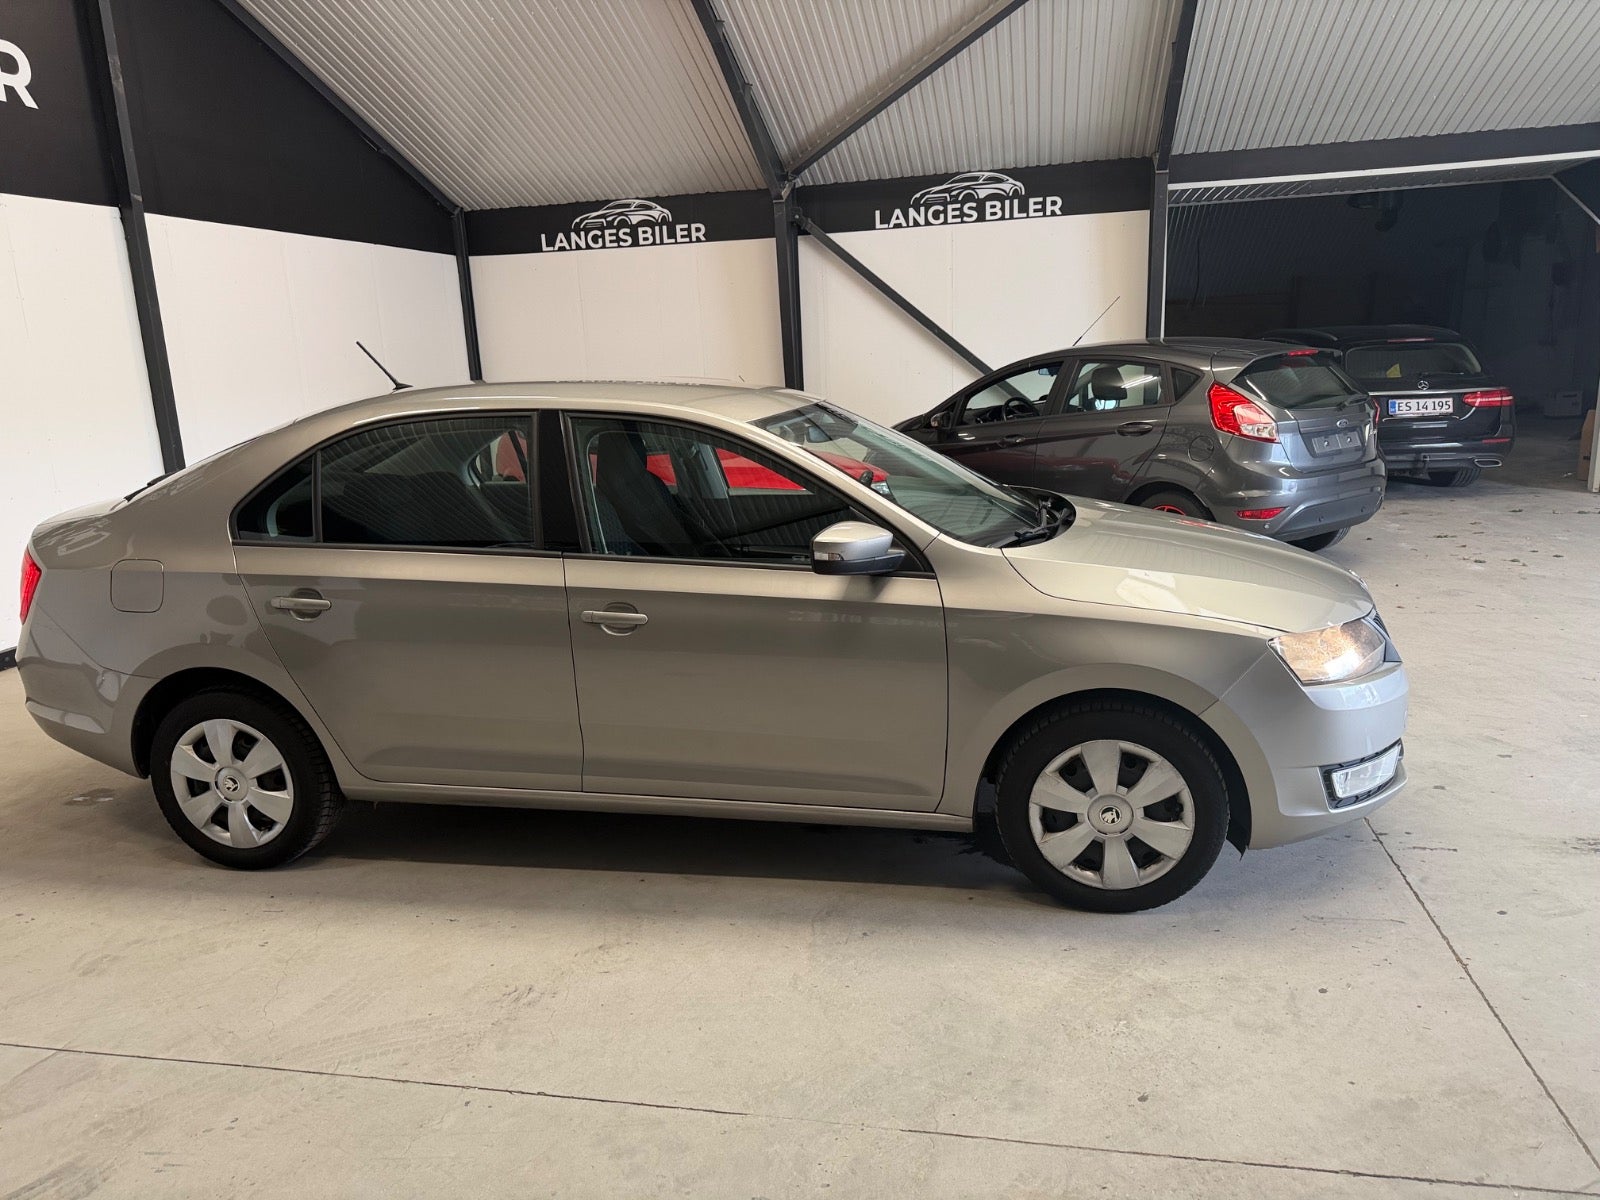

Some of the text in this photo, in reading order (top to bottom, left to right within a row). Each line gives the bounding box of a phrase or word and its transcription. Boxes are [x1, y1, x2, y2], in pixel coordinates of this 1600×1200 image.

[874, 196, 1063, 229] LANGES BILER
[540, 223, 707, 252] LANGES BILER
[1397, 400, 1451, 412] ES 14 195
